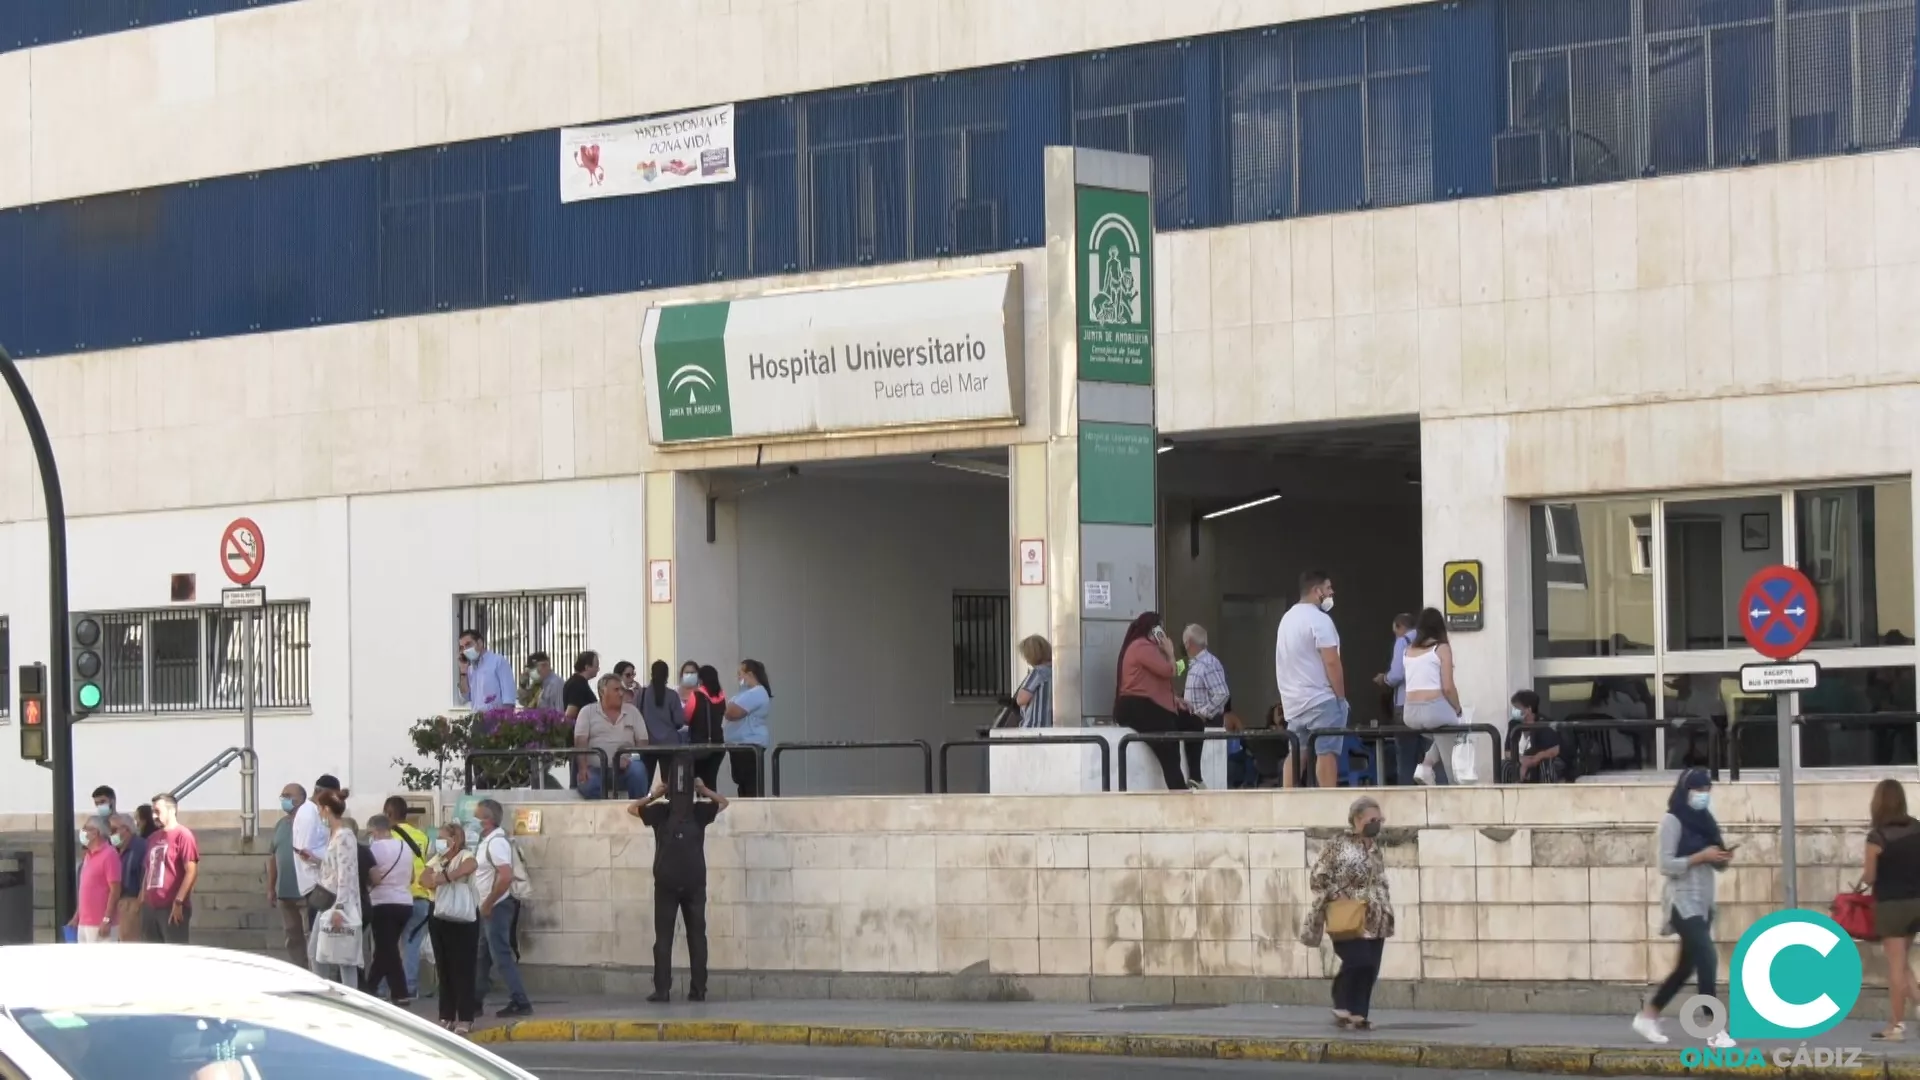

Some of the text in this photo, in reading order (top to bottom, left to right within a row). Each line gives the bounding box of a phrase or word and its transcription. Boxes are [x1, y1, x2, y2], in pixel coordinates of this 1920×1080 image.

[634, 121, 673, 140] HAZTE
[649, 133, 711, 155] DONA VIDA
[1083, 329, 1103, 341] JUNTA
[1105, 331, 1112, 342] DE
[748, 333, 986, 384] Hospital Universitario
[874, 372, 989, 400] Puerta del Mar
[669, 407, 685, 417] JUNTA
[686, 407, 693, 417] DE
[1764, 678, 1810, 686] INTERURBANO
